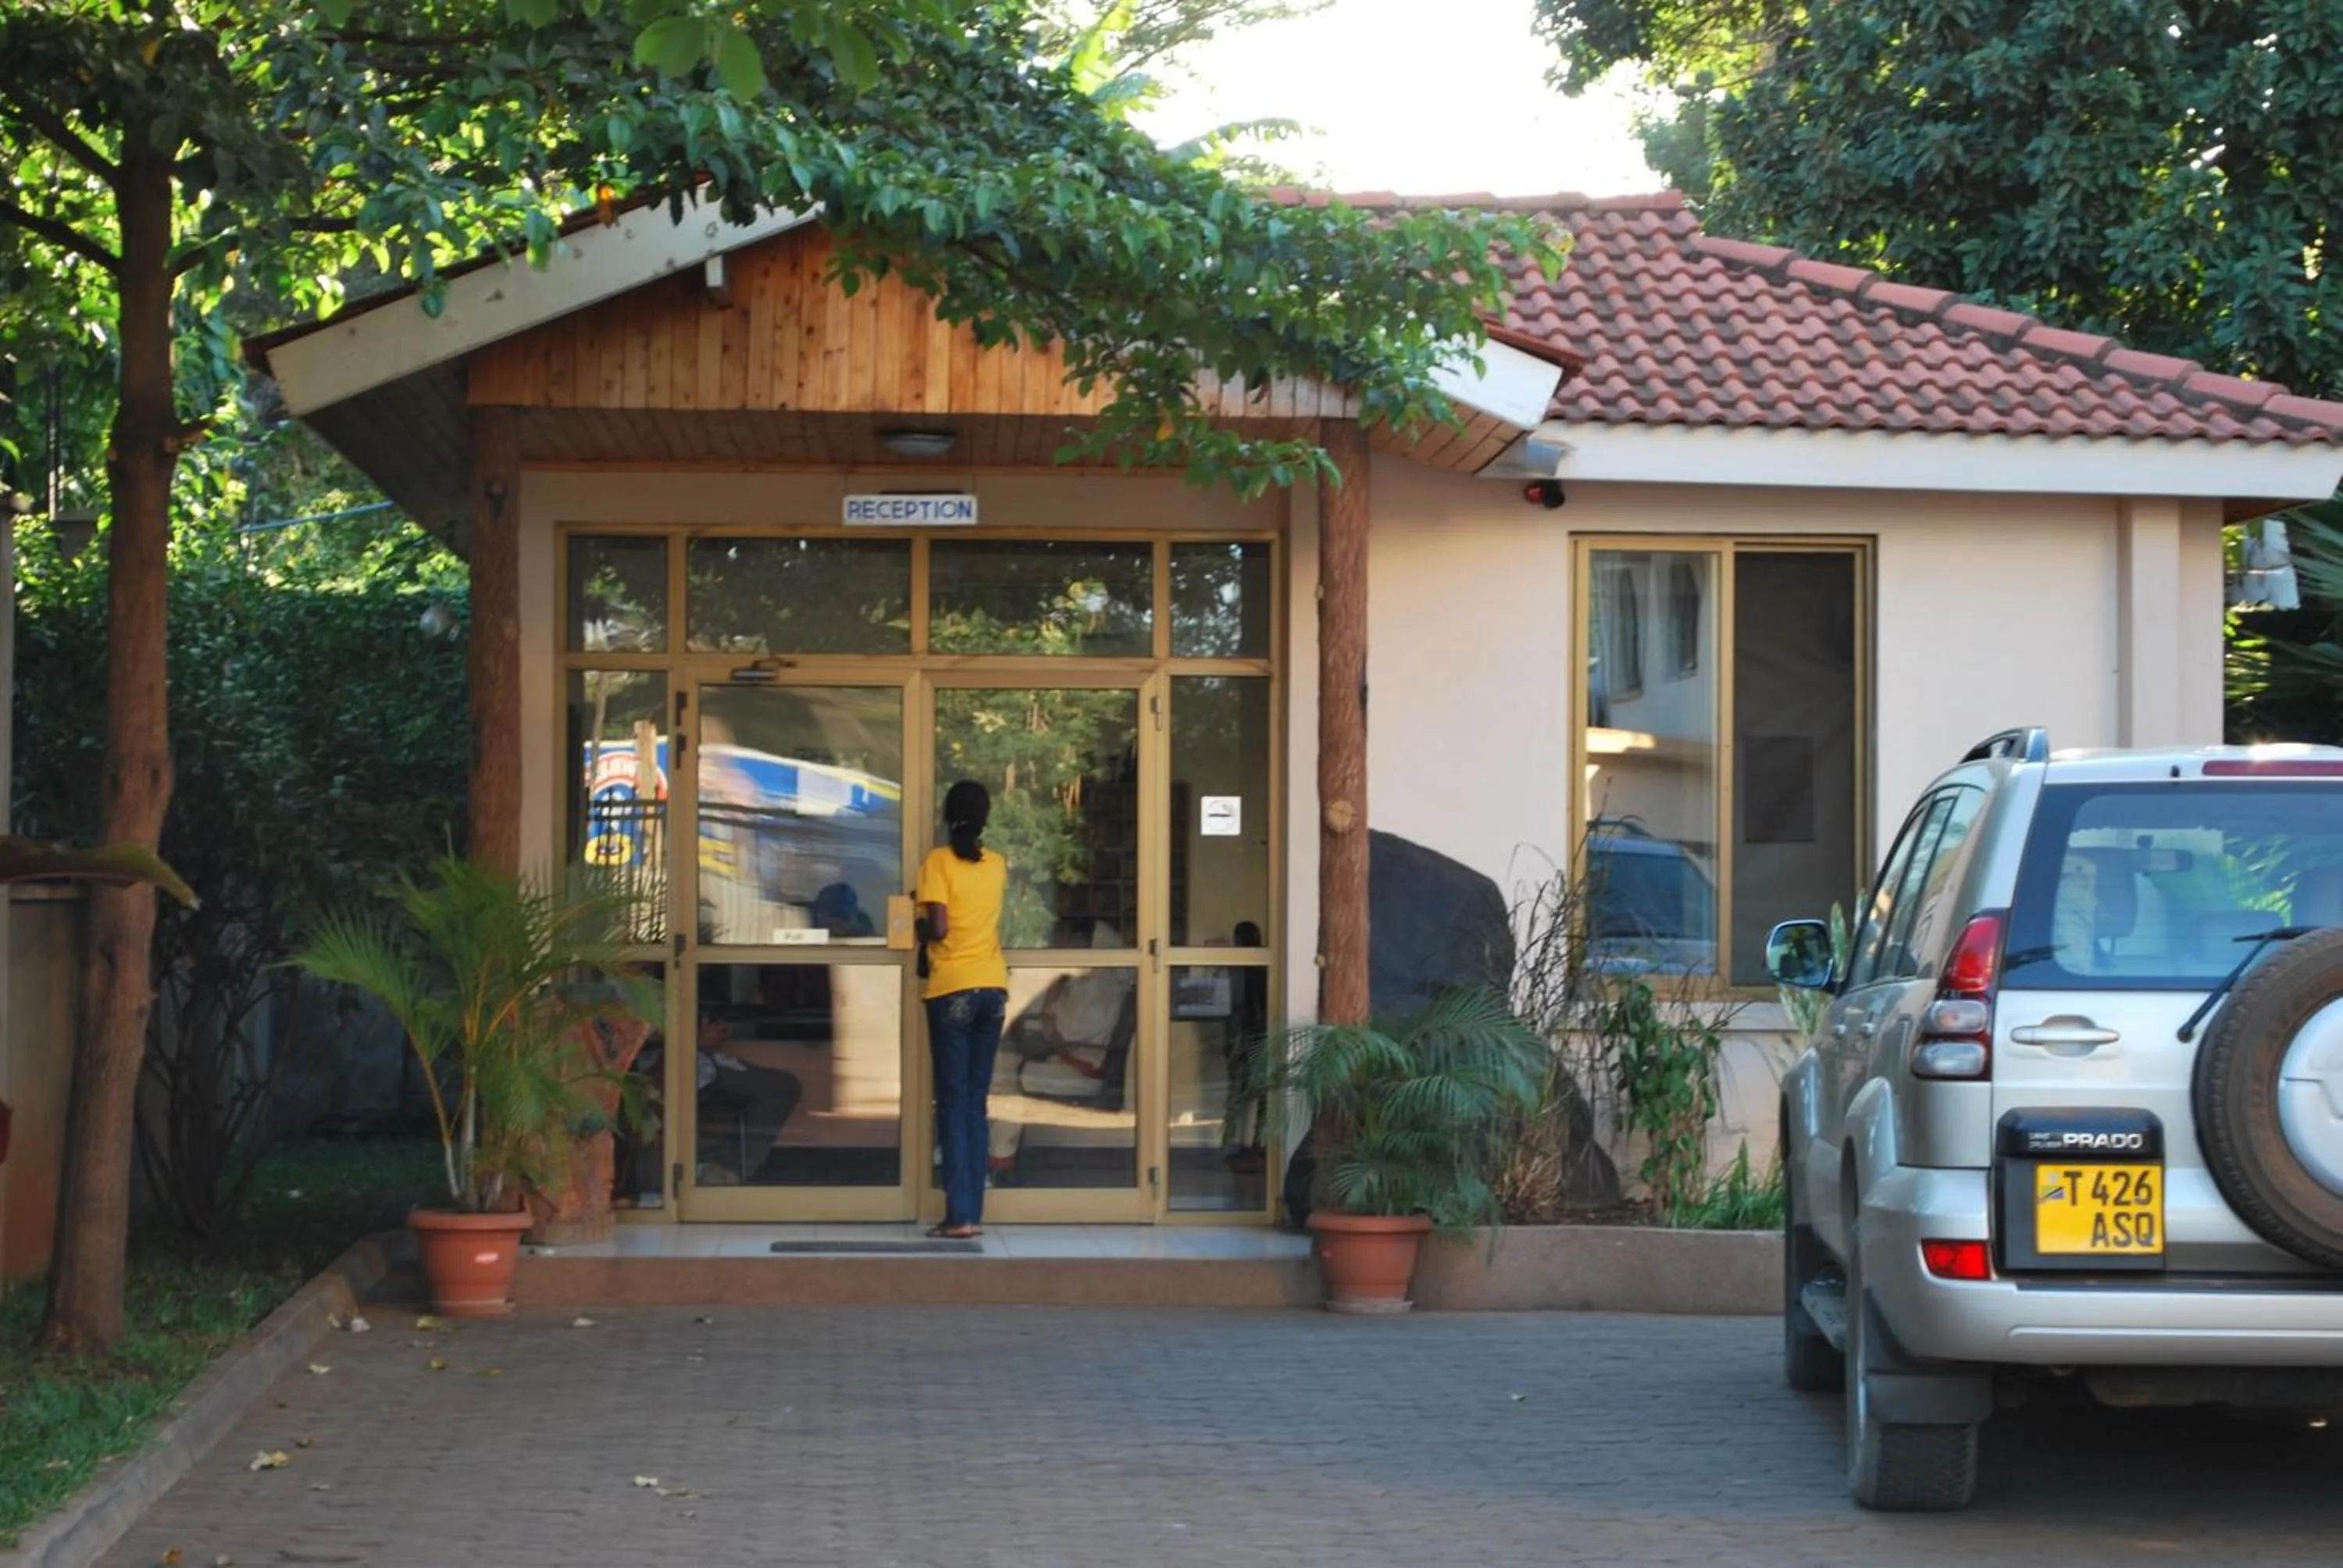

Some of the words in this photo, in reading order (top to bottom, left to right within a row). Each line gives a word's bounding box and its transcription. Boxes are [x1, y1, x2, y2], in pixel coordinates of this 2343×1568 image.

[847, 501, 972, 519] RECEPTION
[2063, 1133, 2143, 1149] PRADO
[2063, 1171, 2083, 1206] T
[2091, 1171, 2152, 1206] 426
[2091, 1212, 2155, 1248] ASQ
